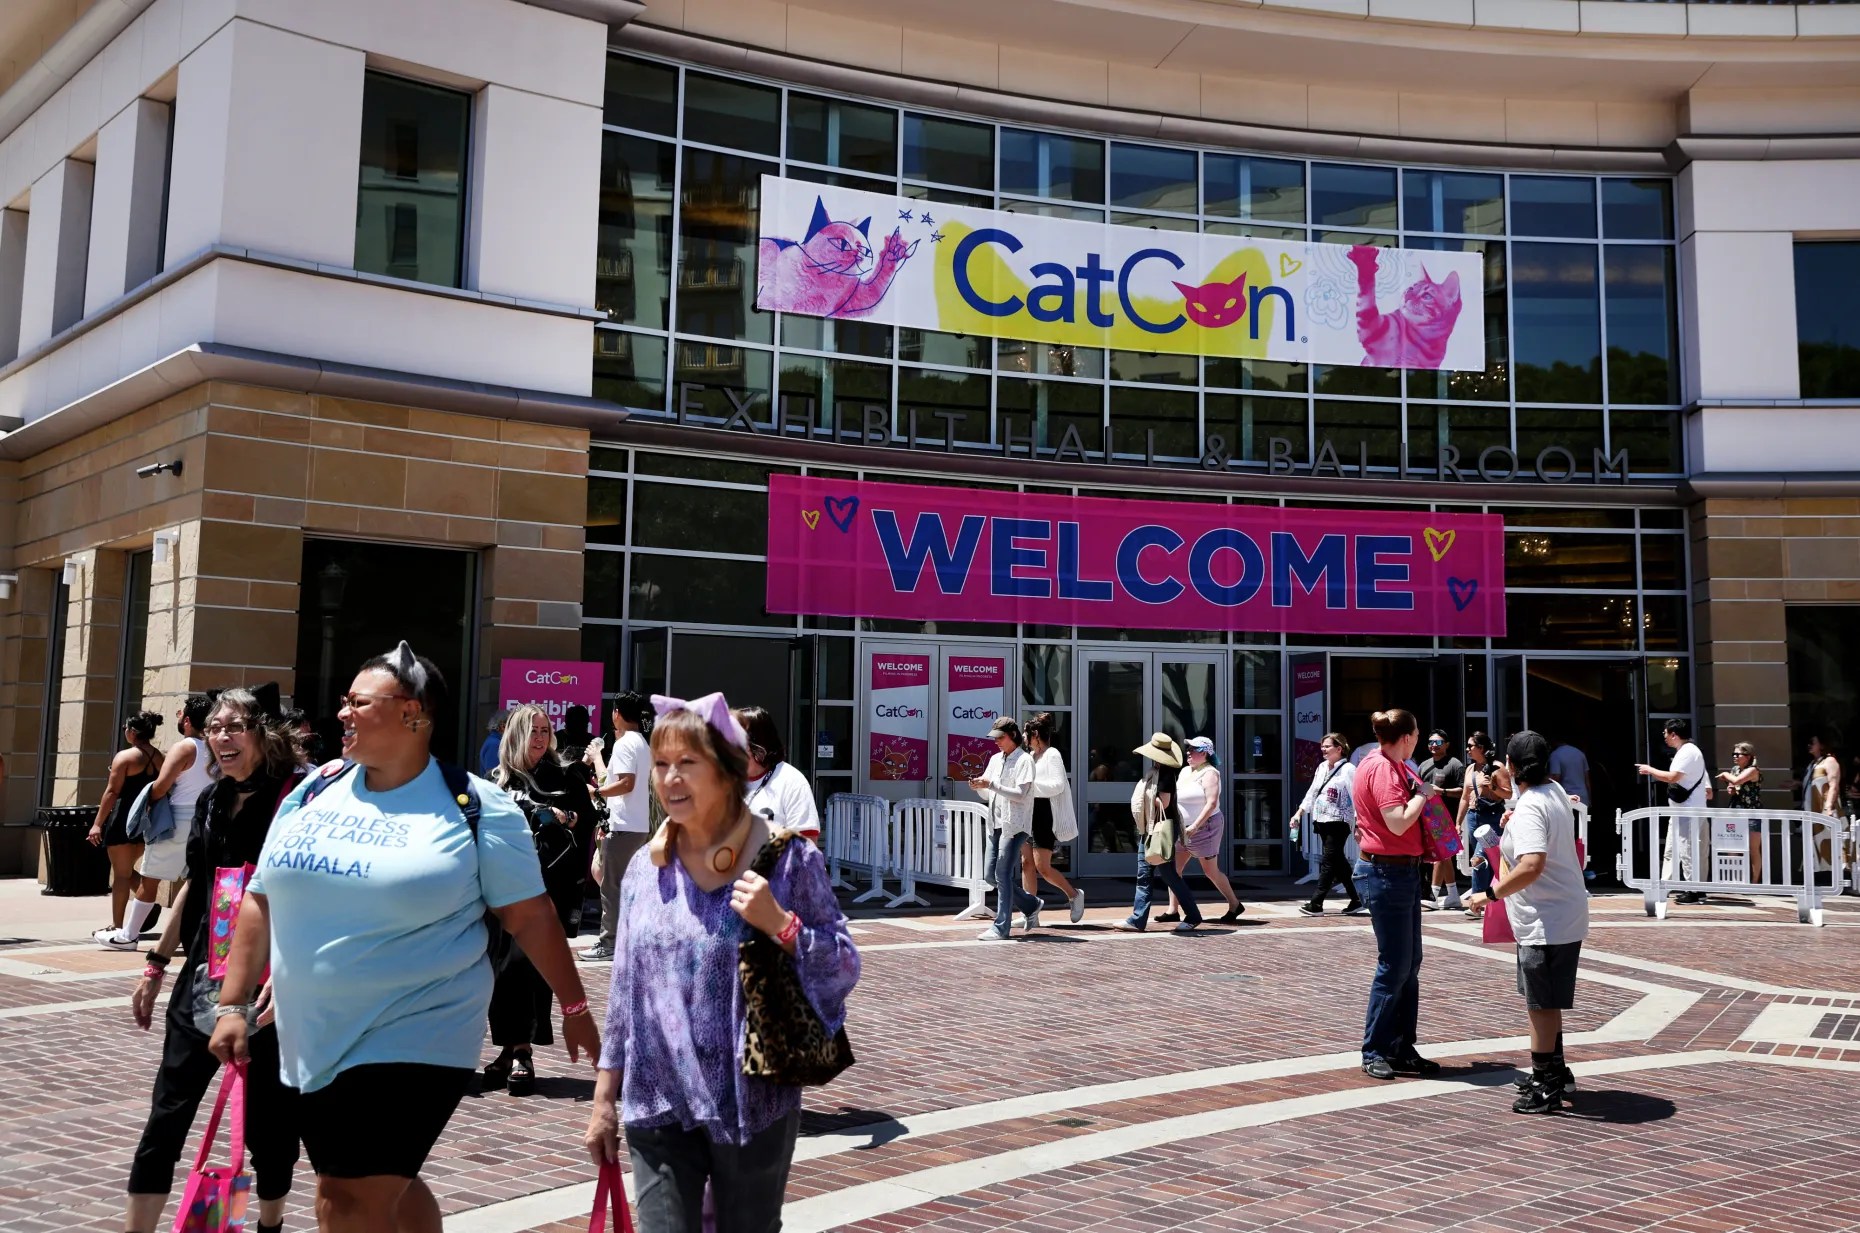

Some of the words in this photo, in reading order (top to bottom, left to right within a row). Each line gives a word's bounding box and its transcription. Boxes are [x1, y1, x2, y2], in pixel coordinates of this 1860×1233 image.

[679, 382, 967, 453] EXHIBIT
[1004, 417, 1167, 468] HALL
[1201, 434, 1233, 472] &
[1268, 436, 1630, 486] BALLROOM
[871, 508, 1414, 611] WELCOME
[877, 662, 923, 671] WELCOME
[954, 665, 998, 674] WELCOME
[1297, 671, 1321, 680] WELCOME
[287, 822, 328, 836] CAT
[327, 828, 408, 848] LADIES
[302, 810, 411, 836] CHILDLESS
[273, 835, 317, 851] FOR
[266, 850, 371, 879] KAMALA!
